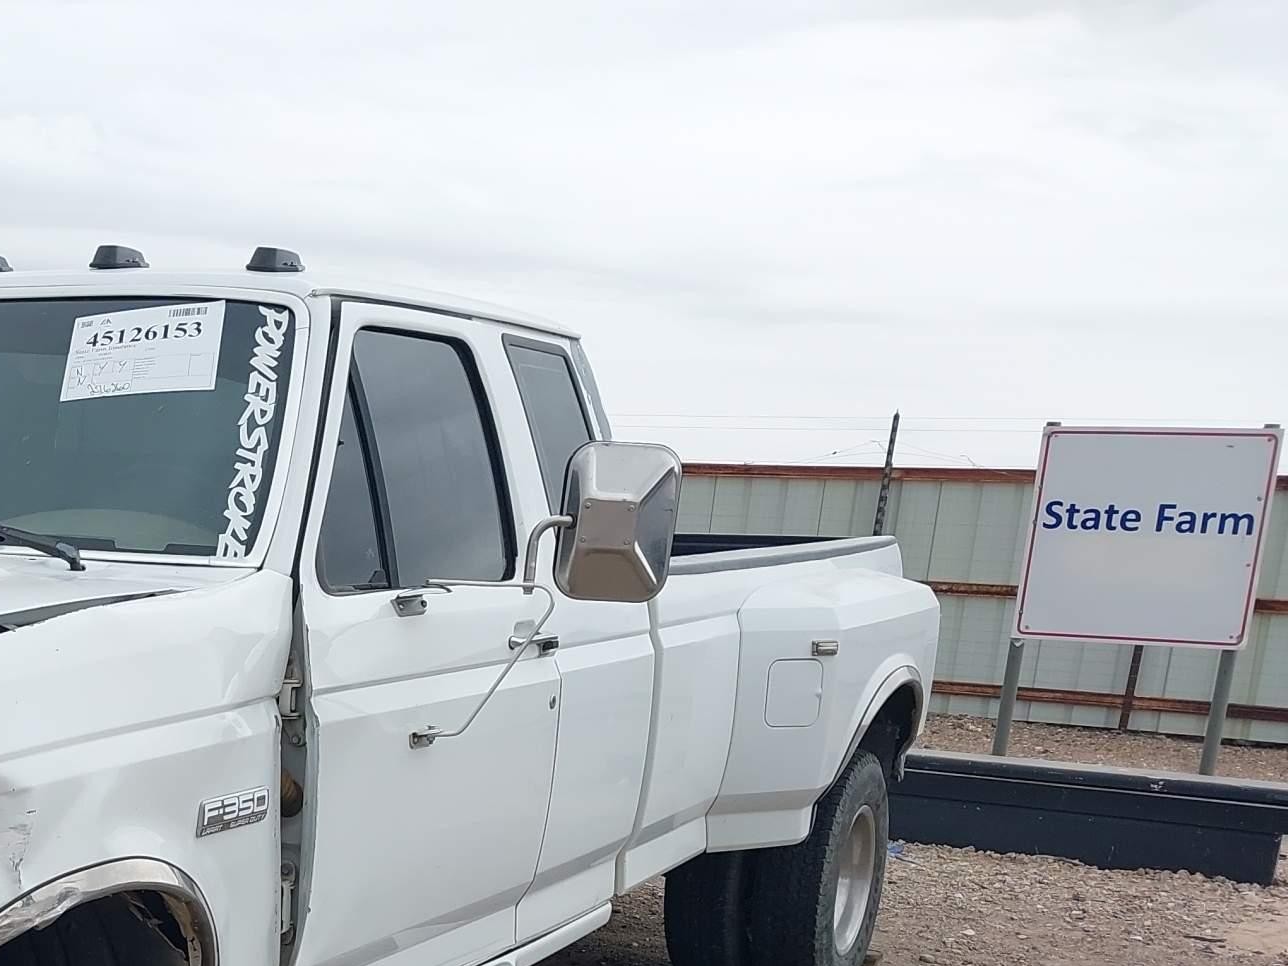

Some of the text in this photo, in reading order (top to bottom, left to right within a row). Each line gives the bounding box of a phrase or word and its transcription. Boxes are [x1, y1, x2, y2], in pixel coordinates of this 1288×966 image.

[86, 321, 203, 347] 45126153
[216, 305, 289, 561] POWERSTROKE
[1042, 500, 1255, 536] State Farm
